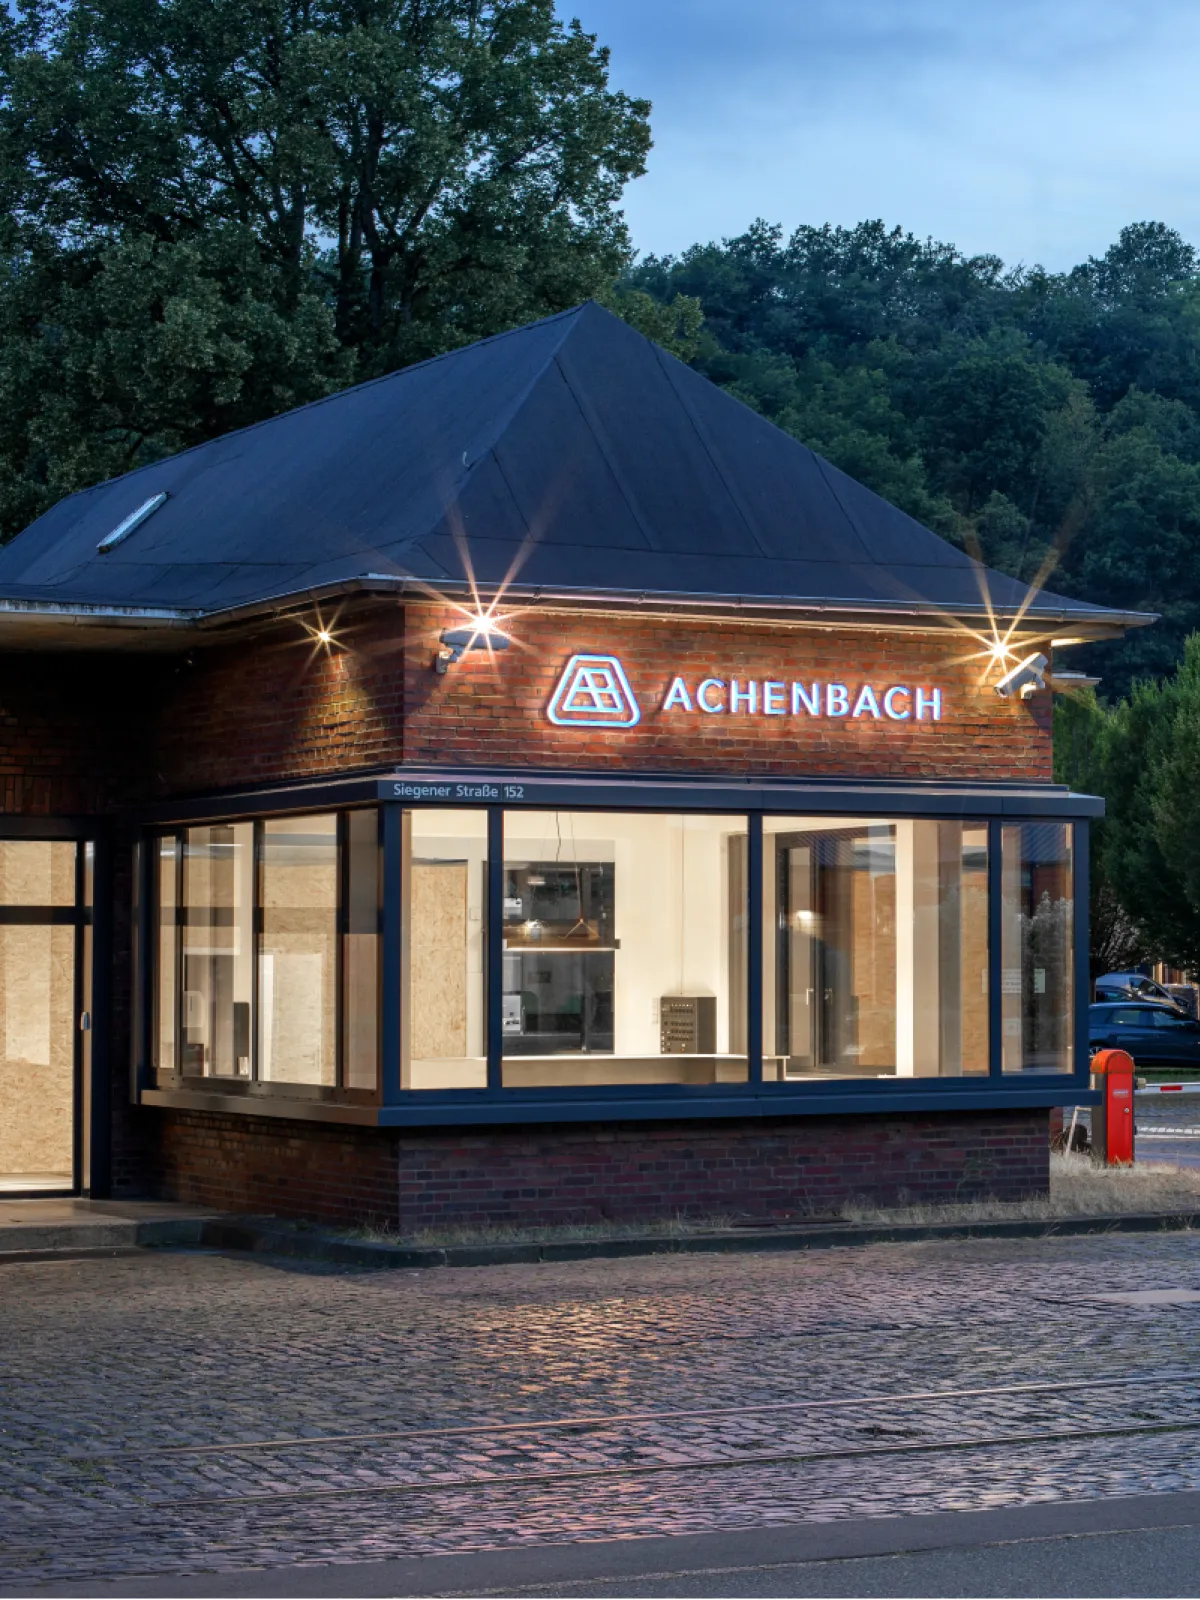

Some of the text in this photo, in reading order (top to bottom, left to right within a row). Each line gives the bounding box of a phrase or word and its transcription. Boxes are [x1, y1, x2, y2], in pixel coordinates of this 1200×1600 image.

[662, 677, 941, 721] ACHENBACH
[393, 783, 524, 799] Siegener Straße 152
